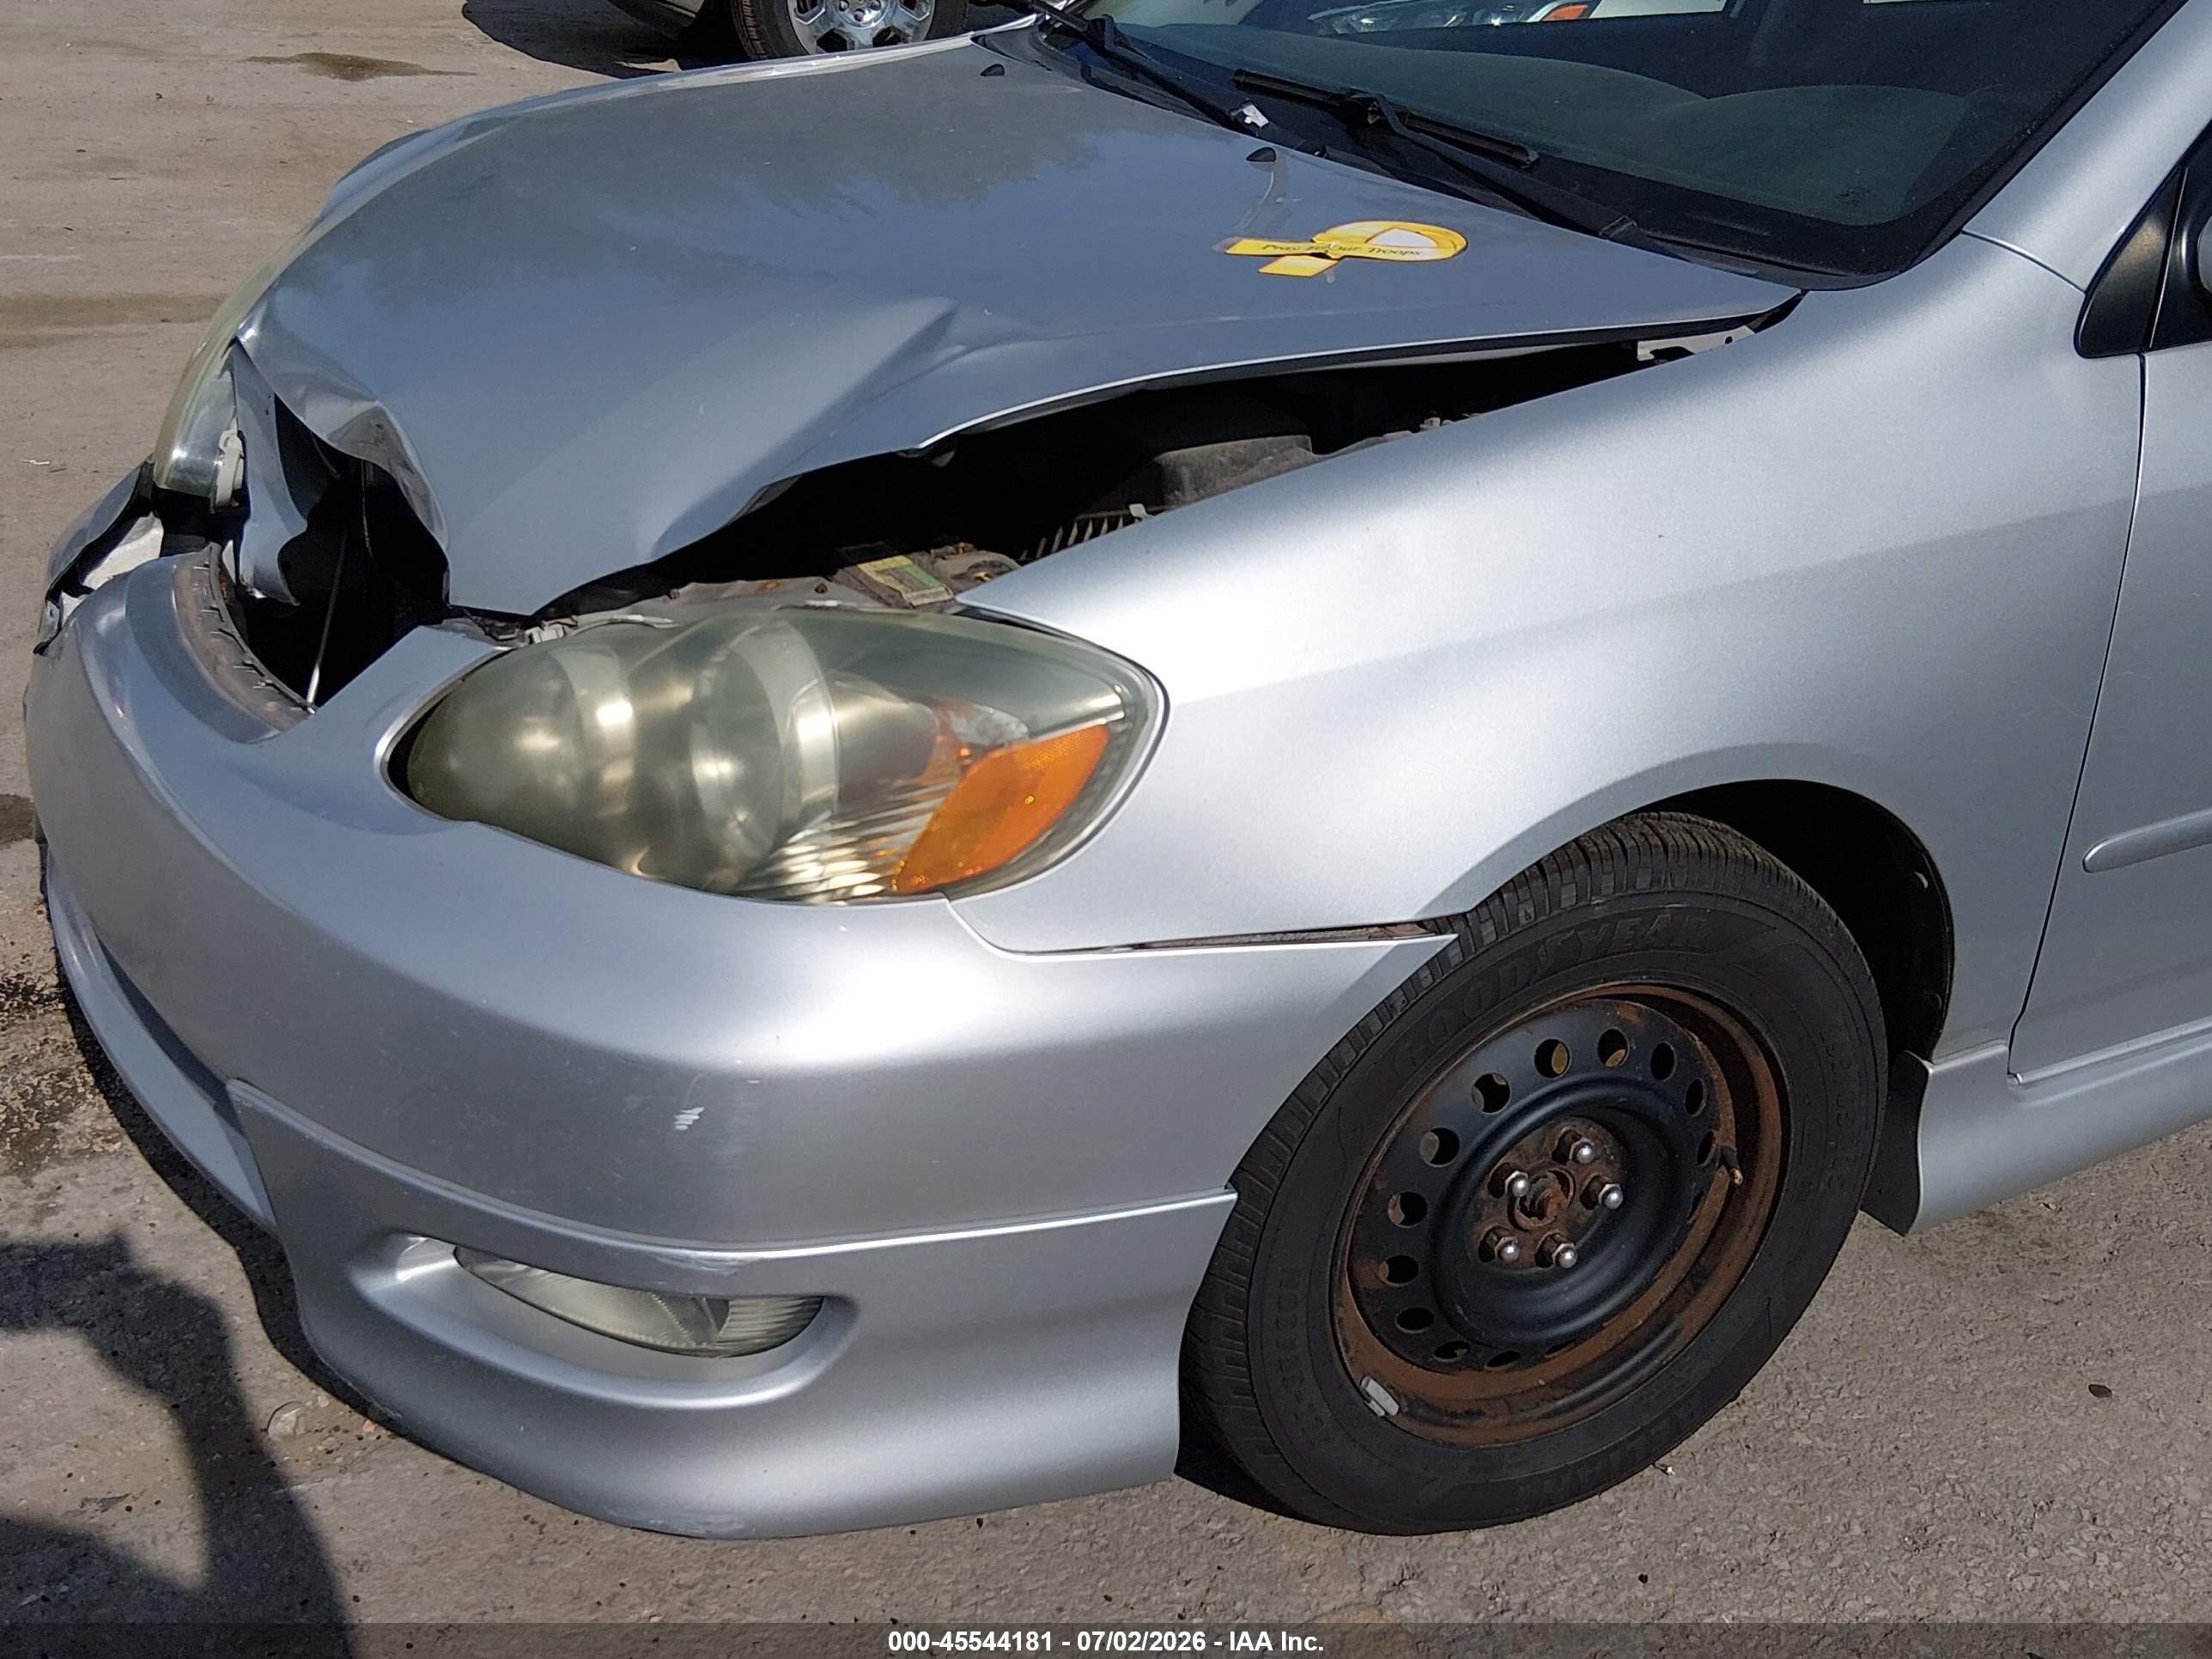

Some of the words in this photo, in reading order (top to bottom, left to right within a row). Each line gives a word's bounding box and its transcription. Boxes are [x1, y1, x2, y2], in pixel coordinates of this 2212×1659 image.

[1261, 244, 1301, 252] Pray
[1368, 246, 1425, 256] Troops
[1395, 912, 1711, 1079] GOODYEAR
